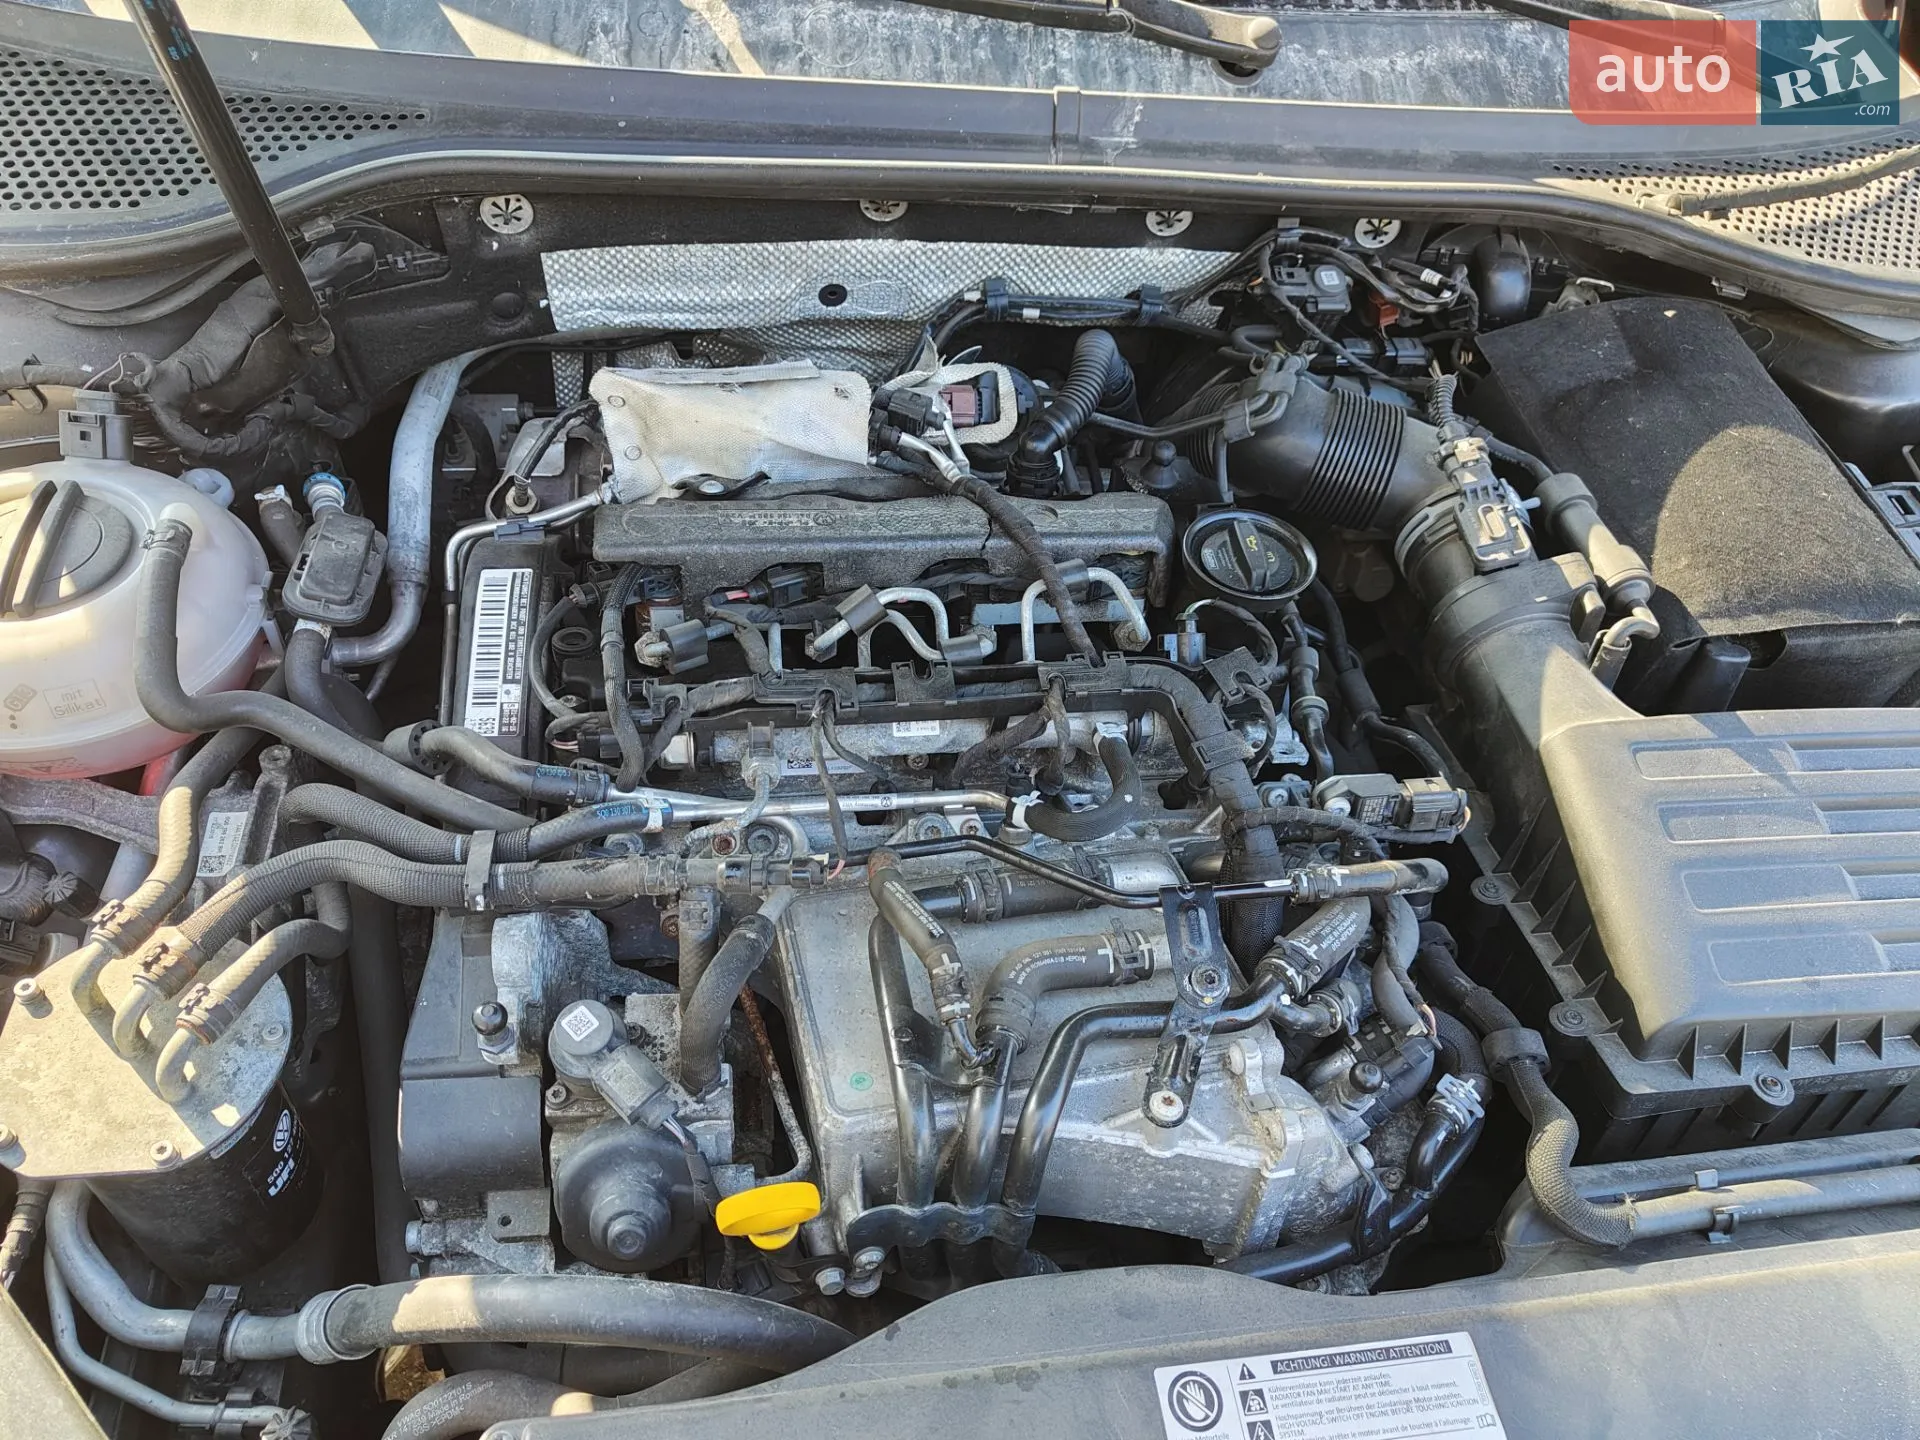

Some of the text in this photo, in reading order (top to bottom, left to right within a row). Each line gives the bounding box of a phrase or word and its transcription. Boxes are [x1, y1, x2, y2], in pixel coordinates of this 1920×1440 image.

[520, 571, 530, 598] ACHTUNG!
[54, 698, 102, 716] Silikat
[1030, 957, 1055, 970] ROMANIA
[266, 1155, 296, 1198] UFI
[1276, 1341, 1449, 1373] ACHTUNG! WARNING! ATTENTION!
[1267, 1380, 1317, 1394] Kühlerventilator
[1318, 1378, 1335, 1387] kann
[1335, 1375, 1362, 1386] jederzeit
[1269, 1391, 1302, 1402] RADIATOR
[1302, 1389, 1316, 1398] FAN
[1317, 1387, 1331, 1396] MAY
[1332, 1384, 1351, 1394] START
[1352, 1383, 1361, 1391] AT
[1361, 1381, 1374, 1390] ANY
[1280, 1398, 1315, 1409] ventilateur
[1324, 1394, 1353, 1403] radiateur
[1354, 1392, 1368, 1400] peut
[1377, 1386, 1410, 1397] déclencher
[1416, 1383, 1430, 1391] tout
[425, 1402, 451, 1419] Made
[456, 1379, 496, 1403] Romania
[1335, 1404, 1364, 1414] Berühren
[1365, 1402, 1376, 1410] der
[1376, 1398, 1413, 1410] Zündanlage
[1414, 1395, 1433, 1404] Motor
[1277, 1421, 1296, 1431] HIGH
[1327, 1414, 1353, 1424] SWITCH
[1353, 1413, 1365, 1421] OFF
[1365, 1409, 1390, 1419] ENGINE
[1391, 1406, 1413, 1416] BEFORE
[1416, 1402, 1449, 1412] TOUCHING
[1450, 1397, 1479, 1408] IGNITION
[1408, 1420, 1432, 1429] toucher
